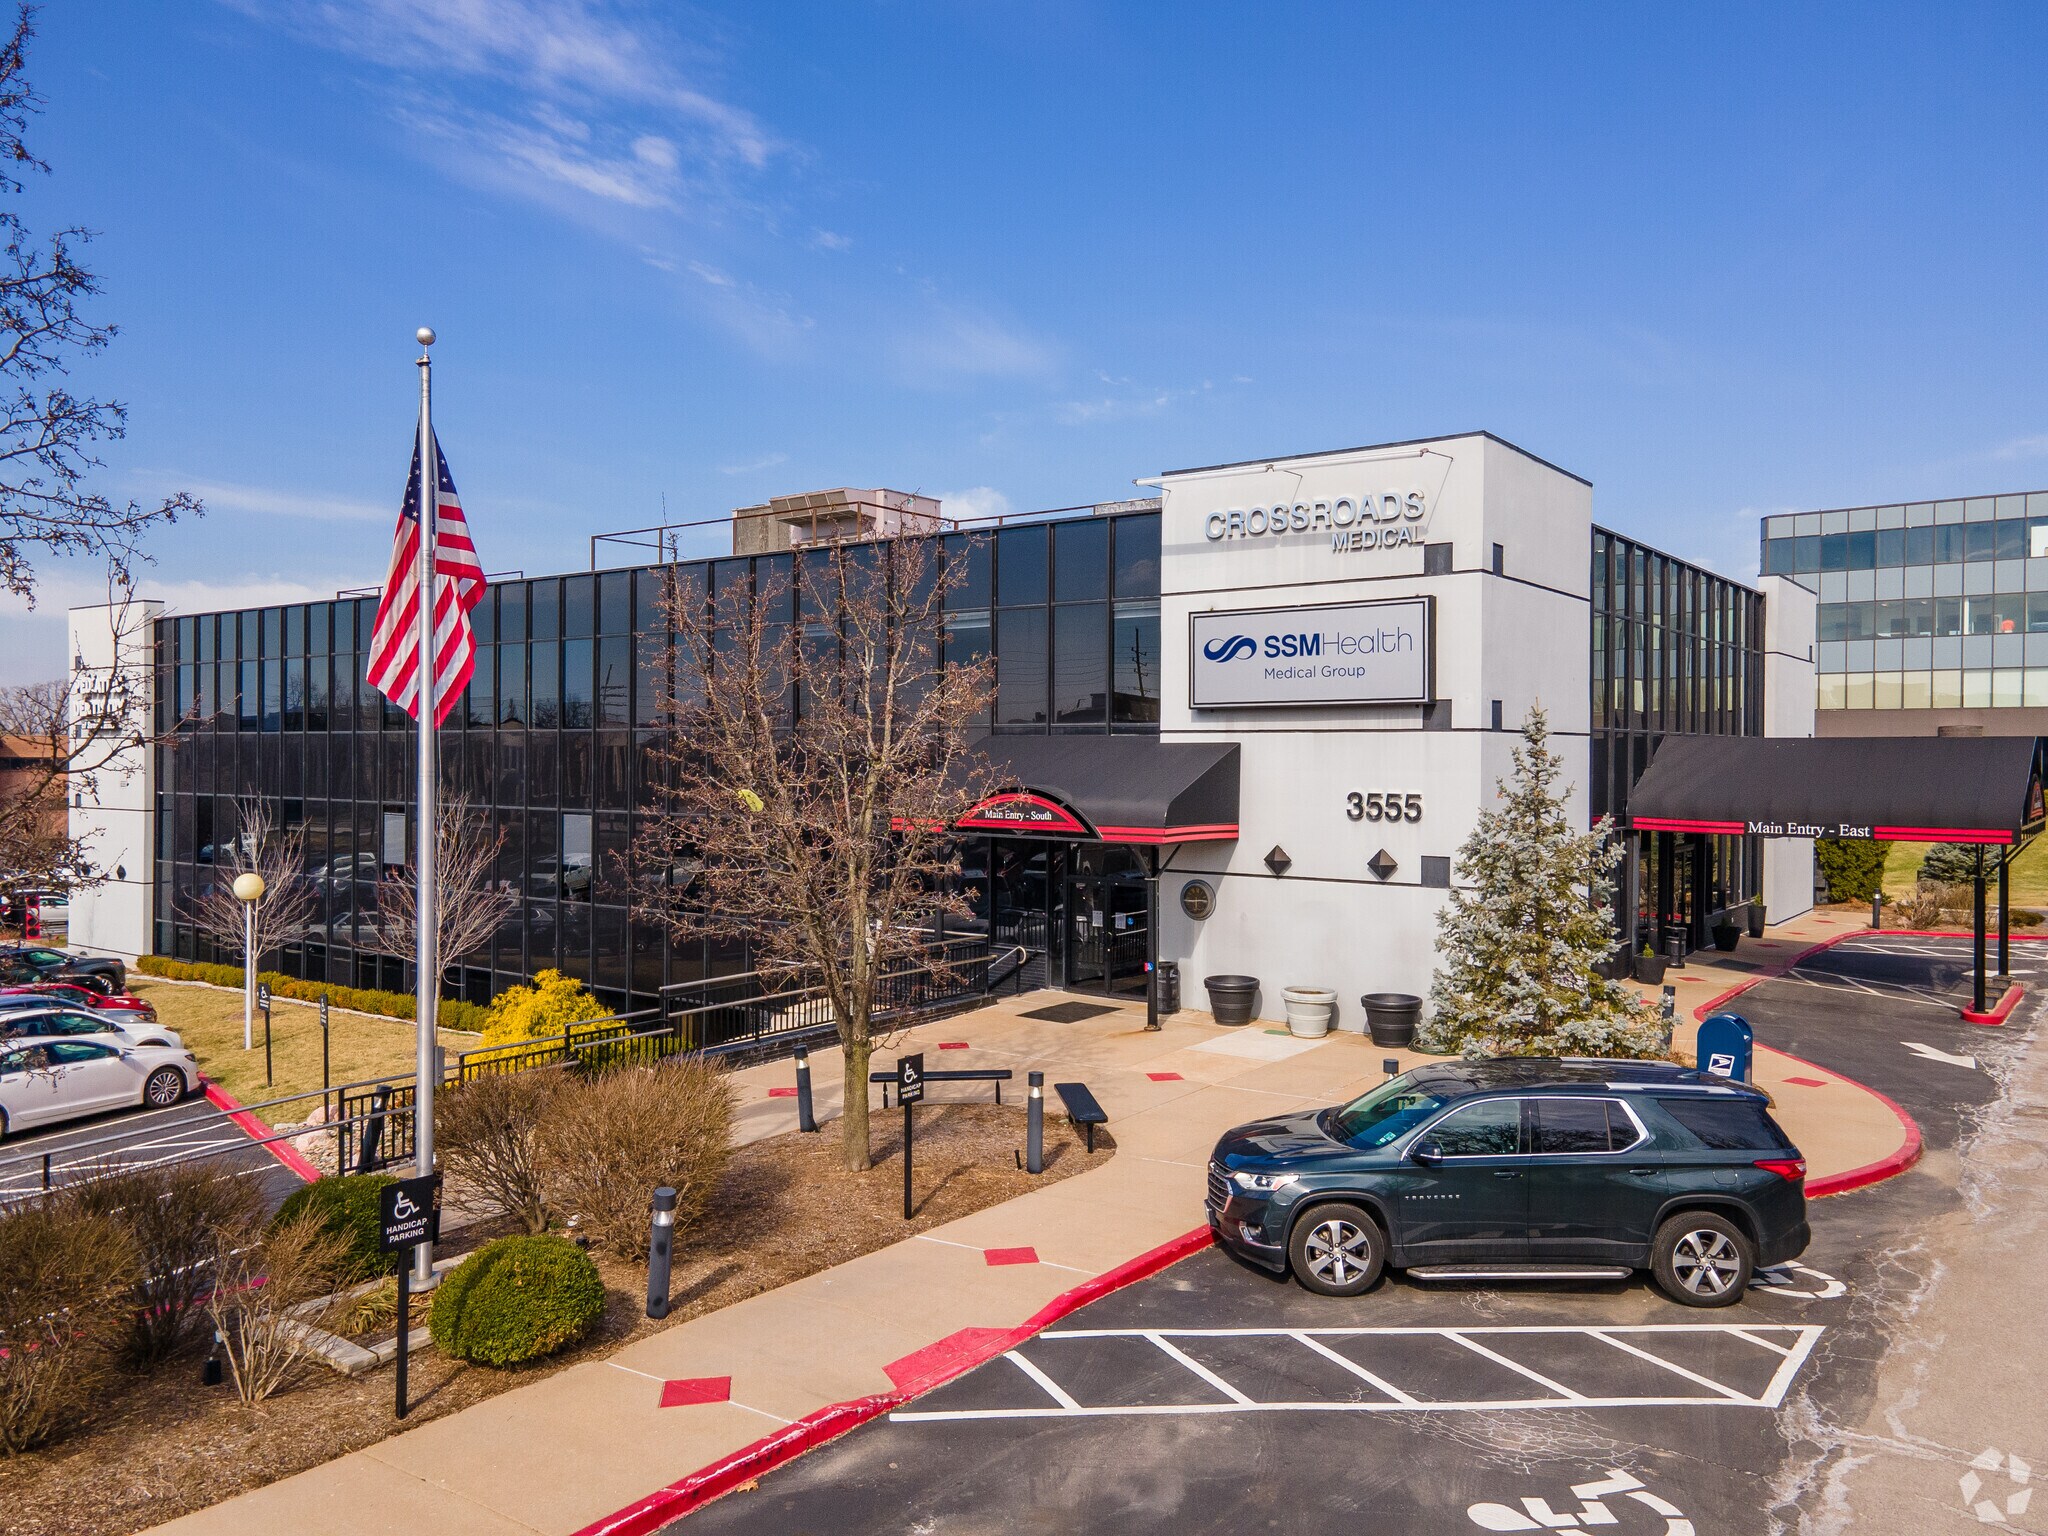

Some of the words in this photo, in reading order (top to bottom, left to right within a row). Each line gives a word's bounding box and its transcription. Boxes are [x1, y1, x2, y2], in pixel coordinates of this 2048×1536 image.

[1205, 489, 1425, 541] CROSSROADS
[1331, 526, 1425, 553] MEDICAL
[1264, 665, 1316, 680] Medical
[1321, 665, 1366, 679] Group
[985, 809, 1003, 819] Main
[1005, 810, 1024, 822] Entry
[1030, 811, 1052, 821] South
[1346, 791, 1423, 824] 3555
[1747, 821, 1783, 834] Main
[1787, 822, 1825, 838] Entry
[1839, 824, 1870, 837] East
[386, 1217, 428, 1235] HANDICAP
[389, 1227, 425, 1243] PARKING
